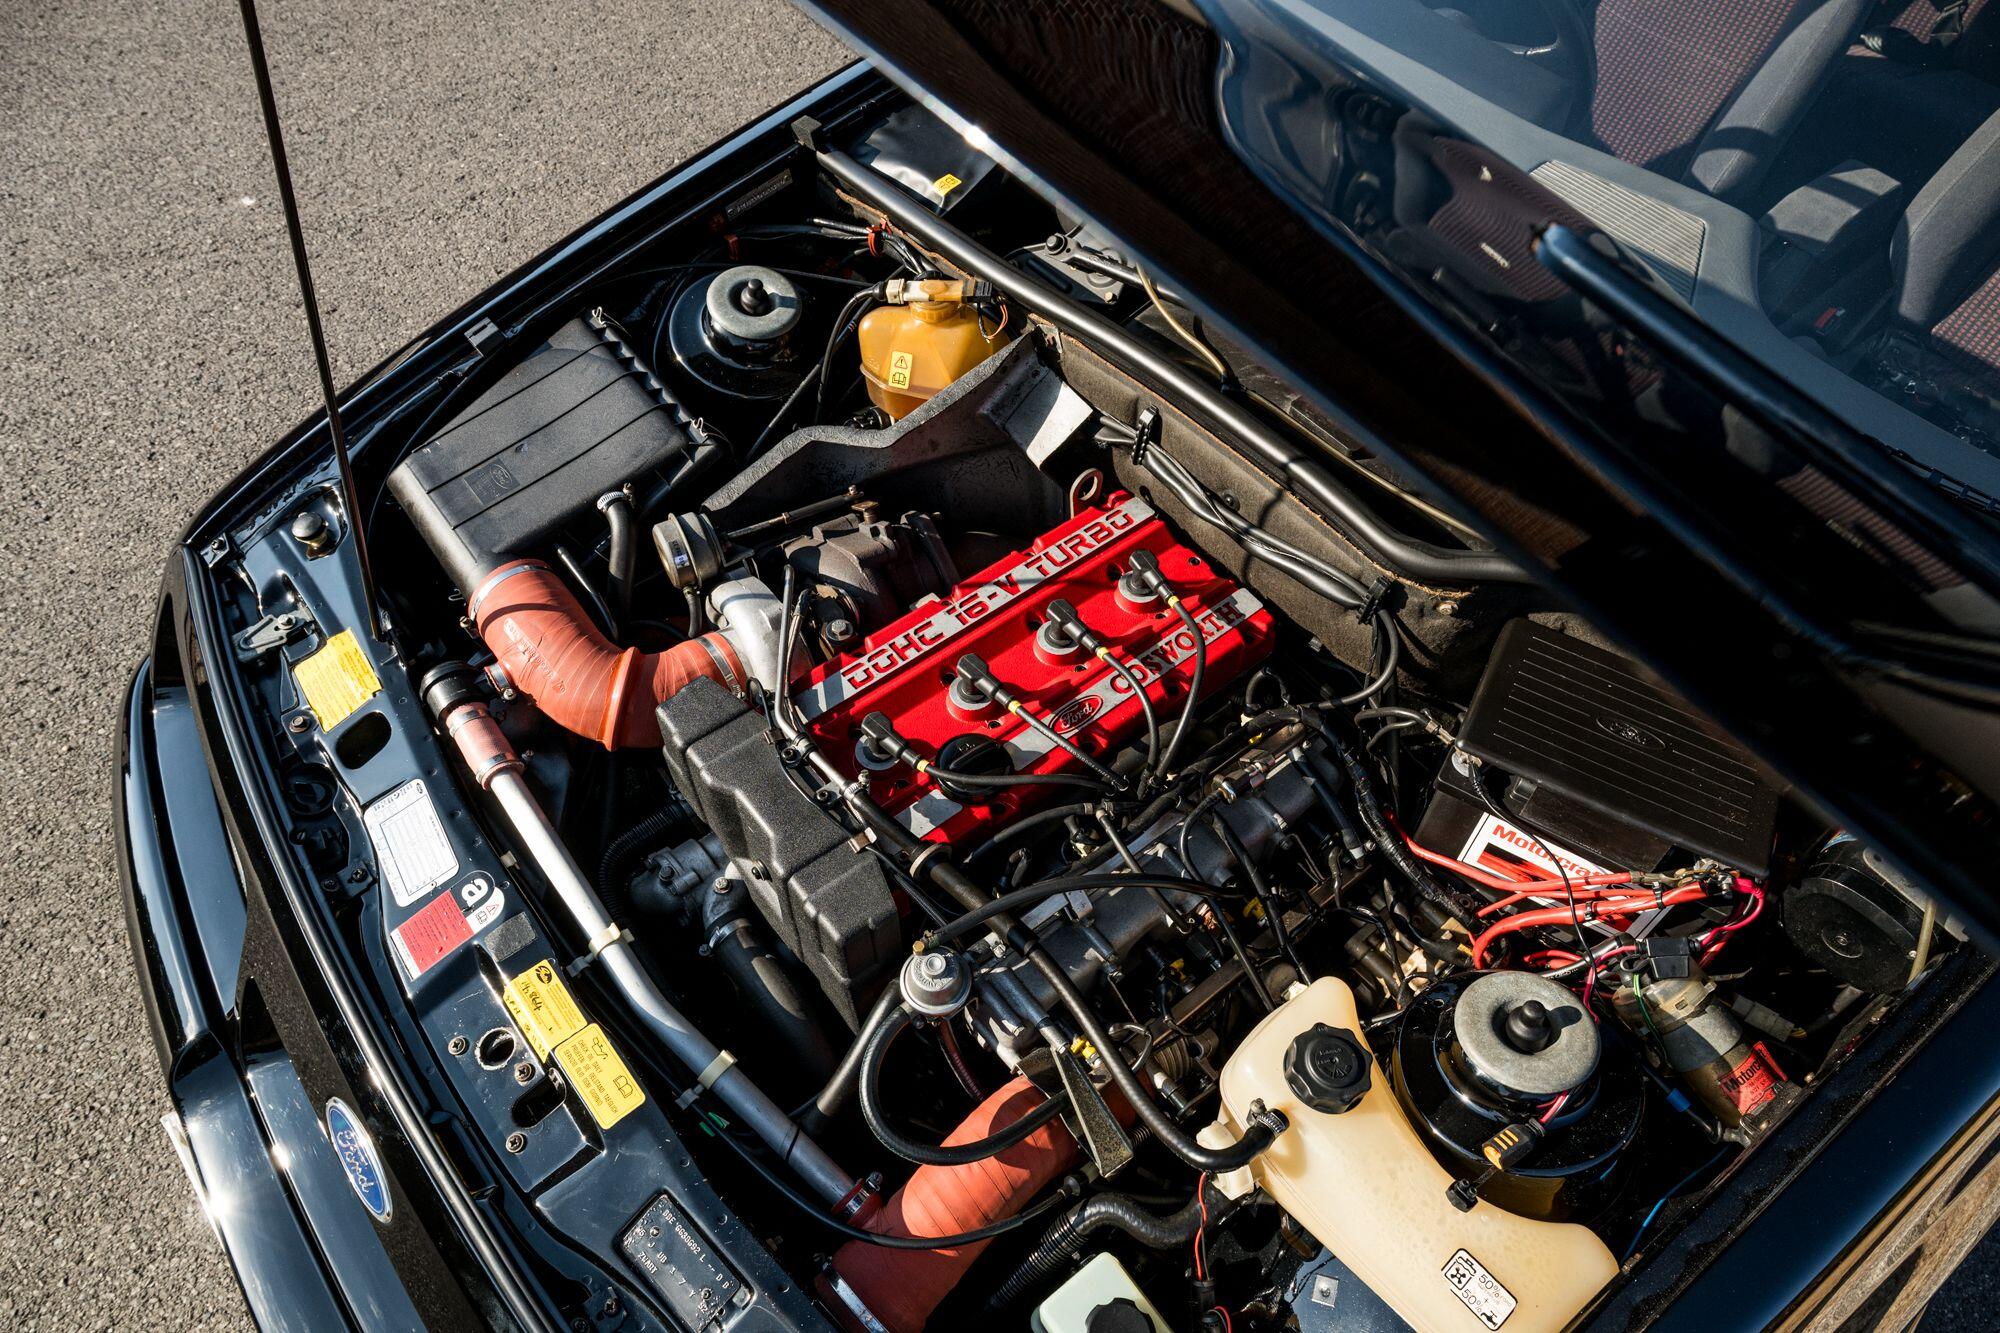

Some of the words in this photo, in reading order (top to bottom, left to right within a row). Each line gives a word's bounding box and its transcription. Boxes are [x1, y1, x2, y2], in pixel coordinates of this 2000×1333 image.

[841, 619, 944, 689] DOHC
[945, 573, 1021, 626] 16-V
[1024, 509, 1135, 577] TURBO
[1059, 702, 1093, 729] Ford
[335, 1128, 374, 1193] Ford
[1477, 1272, 1503, 1298] 50%
[1461, 1288, 1481, 1313] 50%
